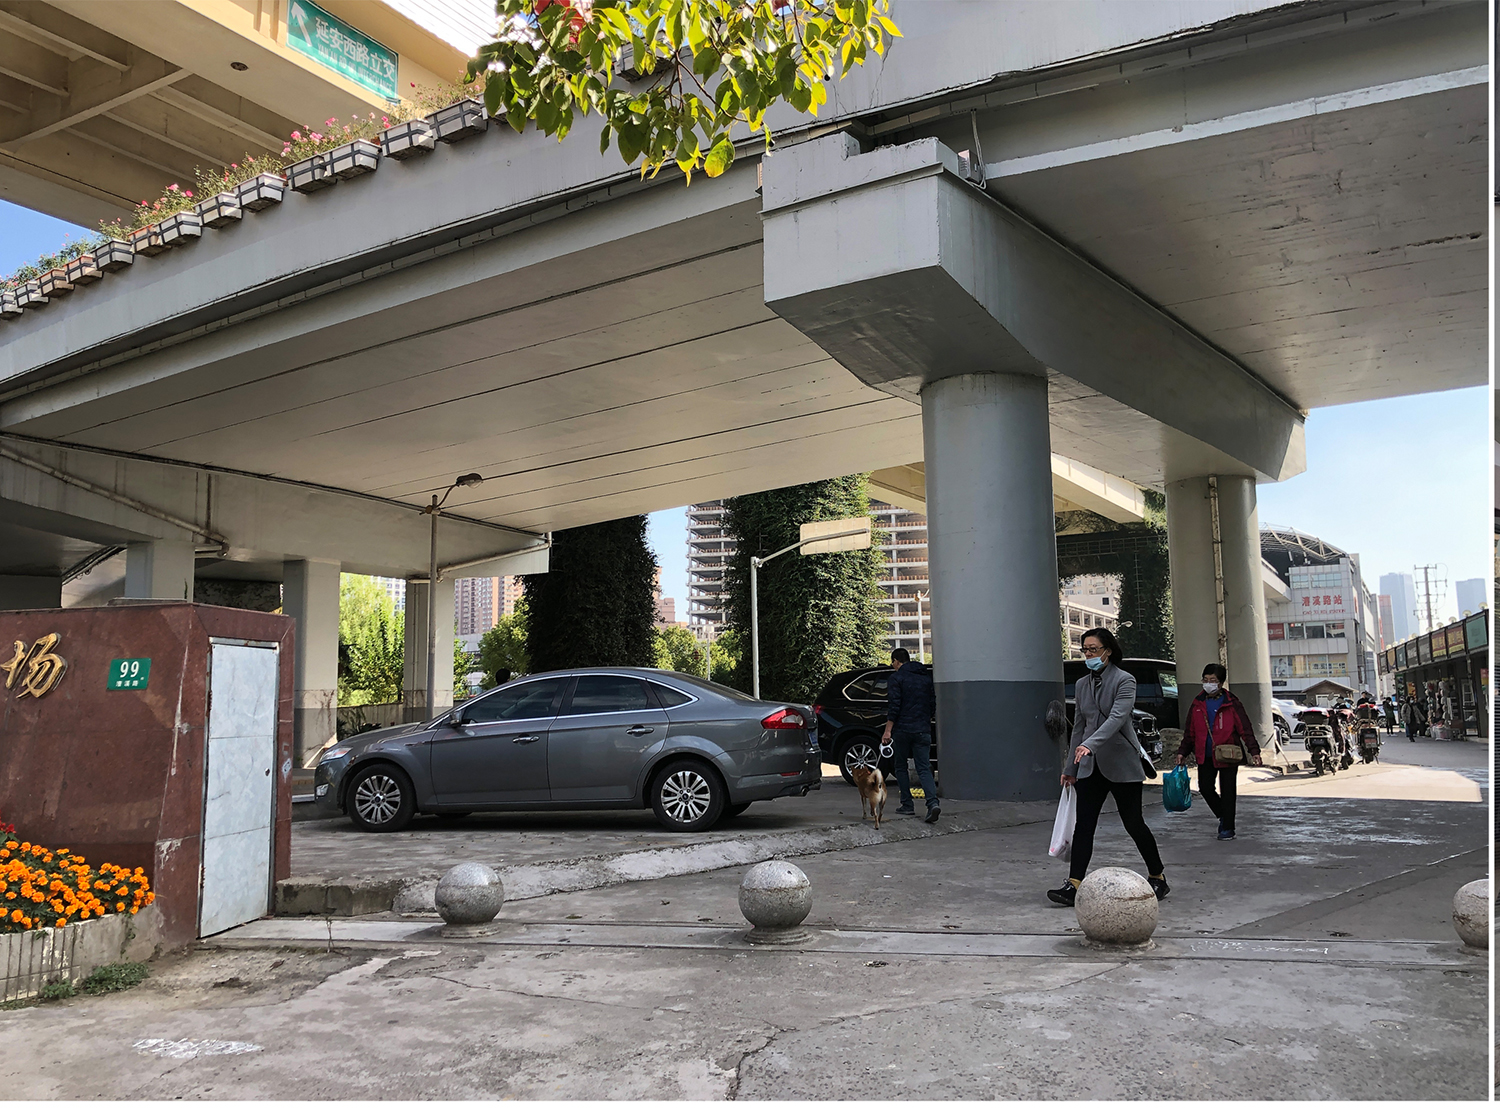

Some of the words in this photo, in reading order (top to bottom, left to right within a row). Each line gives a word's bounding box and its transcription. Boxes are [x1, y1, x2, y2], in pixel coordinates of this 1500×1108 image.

[315, 16, 395, 82] 延安西路立交
[1302, 594, 1342, 606] 漕溪路站
[120, 661, 139, 678] 99
